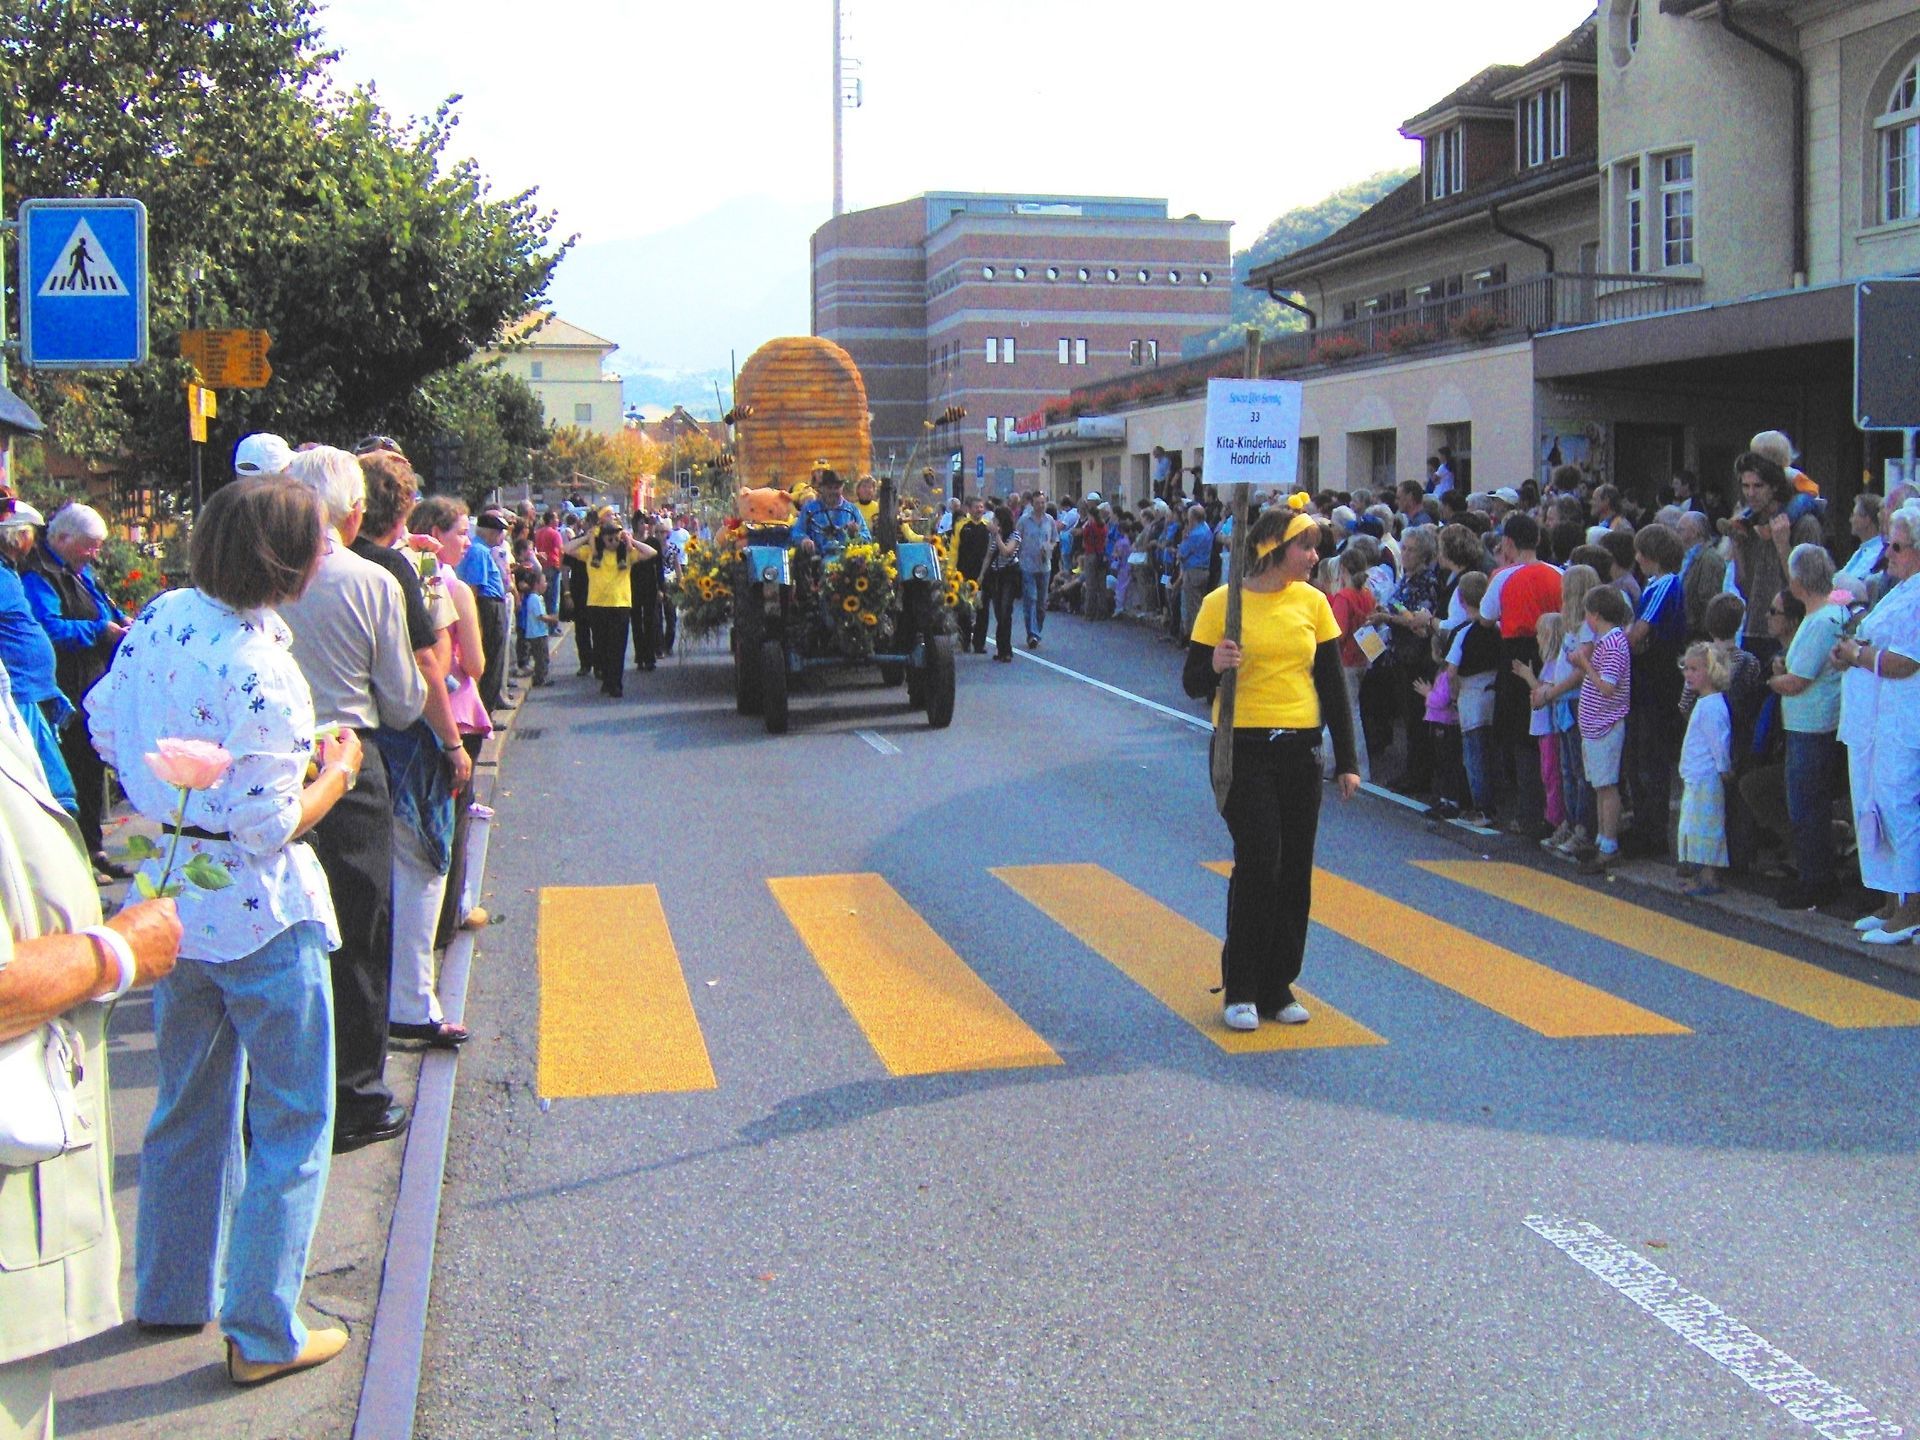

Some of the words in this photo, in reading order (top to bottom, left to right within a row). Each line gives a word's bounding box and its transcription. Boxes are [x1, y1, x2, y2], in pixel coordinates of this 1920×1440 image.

[1250, 411, 1260, 422] 33
[1216, 436, 1287, 449] Kita-Kinderhaus
[1230, 452, 1271, 464] Hondrich
